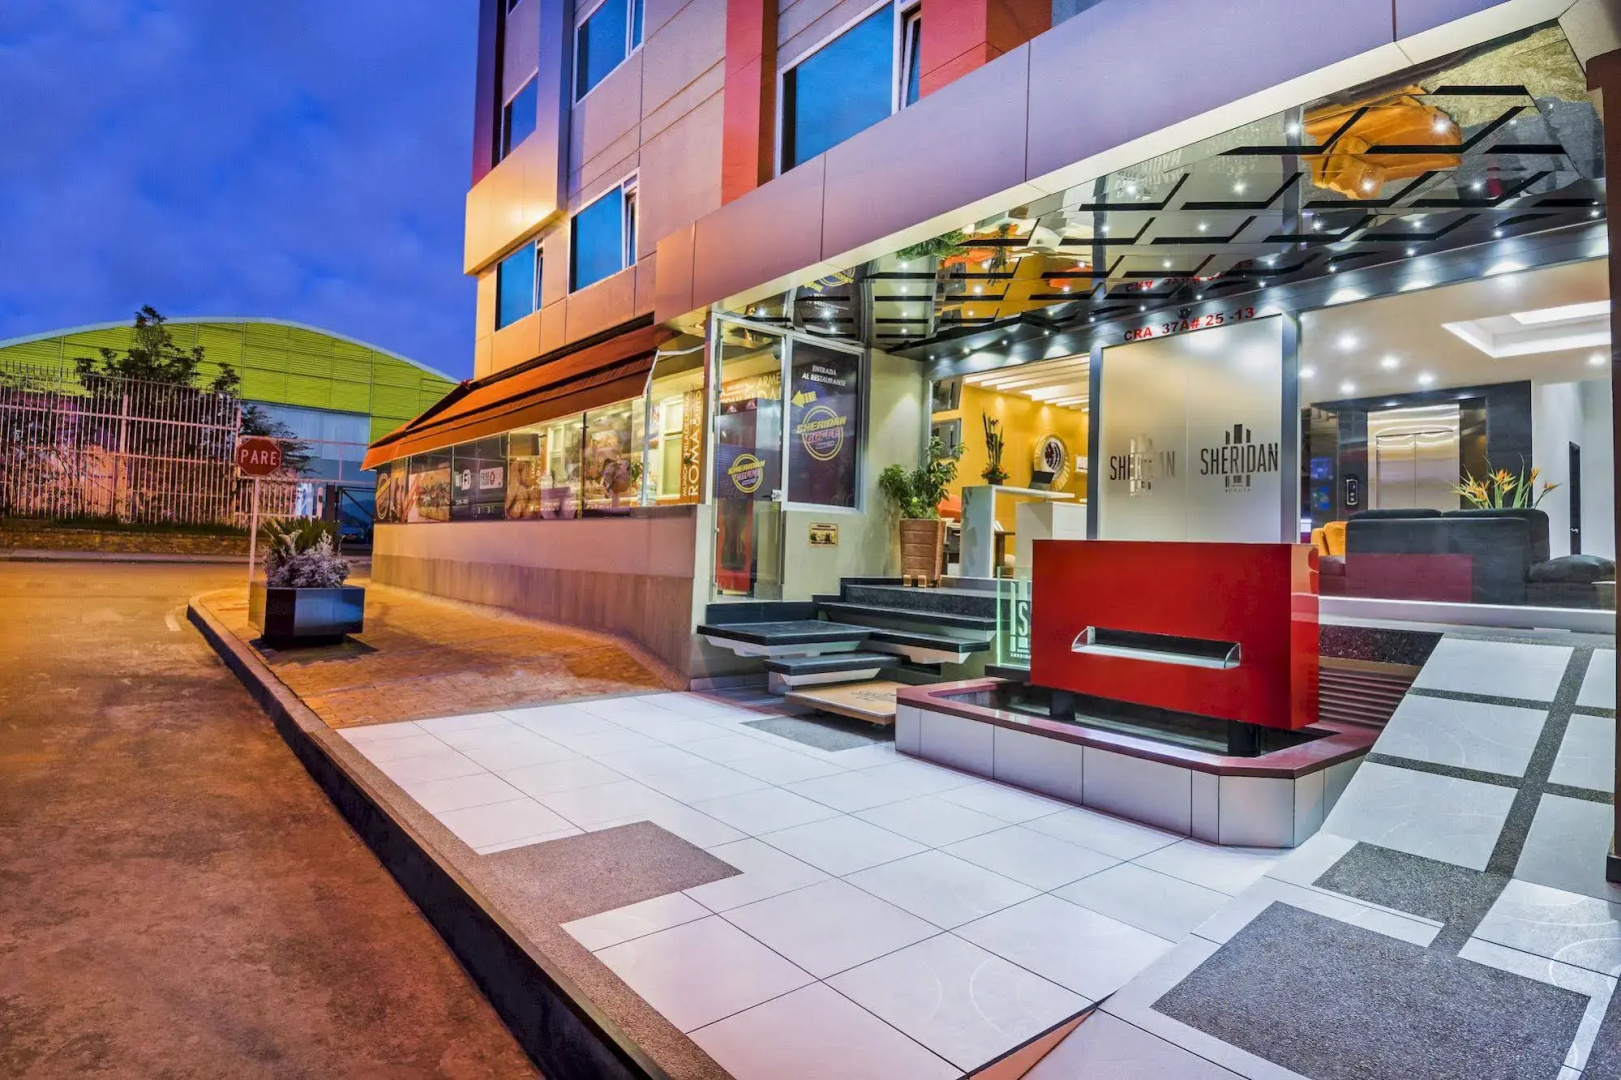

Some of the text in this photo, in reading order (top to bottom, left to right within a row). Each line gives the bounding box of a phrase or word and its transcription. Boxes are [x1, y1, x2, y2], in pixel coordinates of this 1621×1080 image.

[1124, 327, 1153, 341] CRA
[1205, 313, 1224, 326] 25
[812, 365, 837, 376] ENTRADA
[801, 372, 847, 387] AL RESTAURANTE
[796, 416, 847, 434] SHERIDAN
[240, 449, 278, 466] PARE
[688, 429, 700, 496] ROMA
[1201, 443, 1278, 475] SHERIDAN
[728, 460, 766, 475] SHERIDAN
